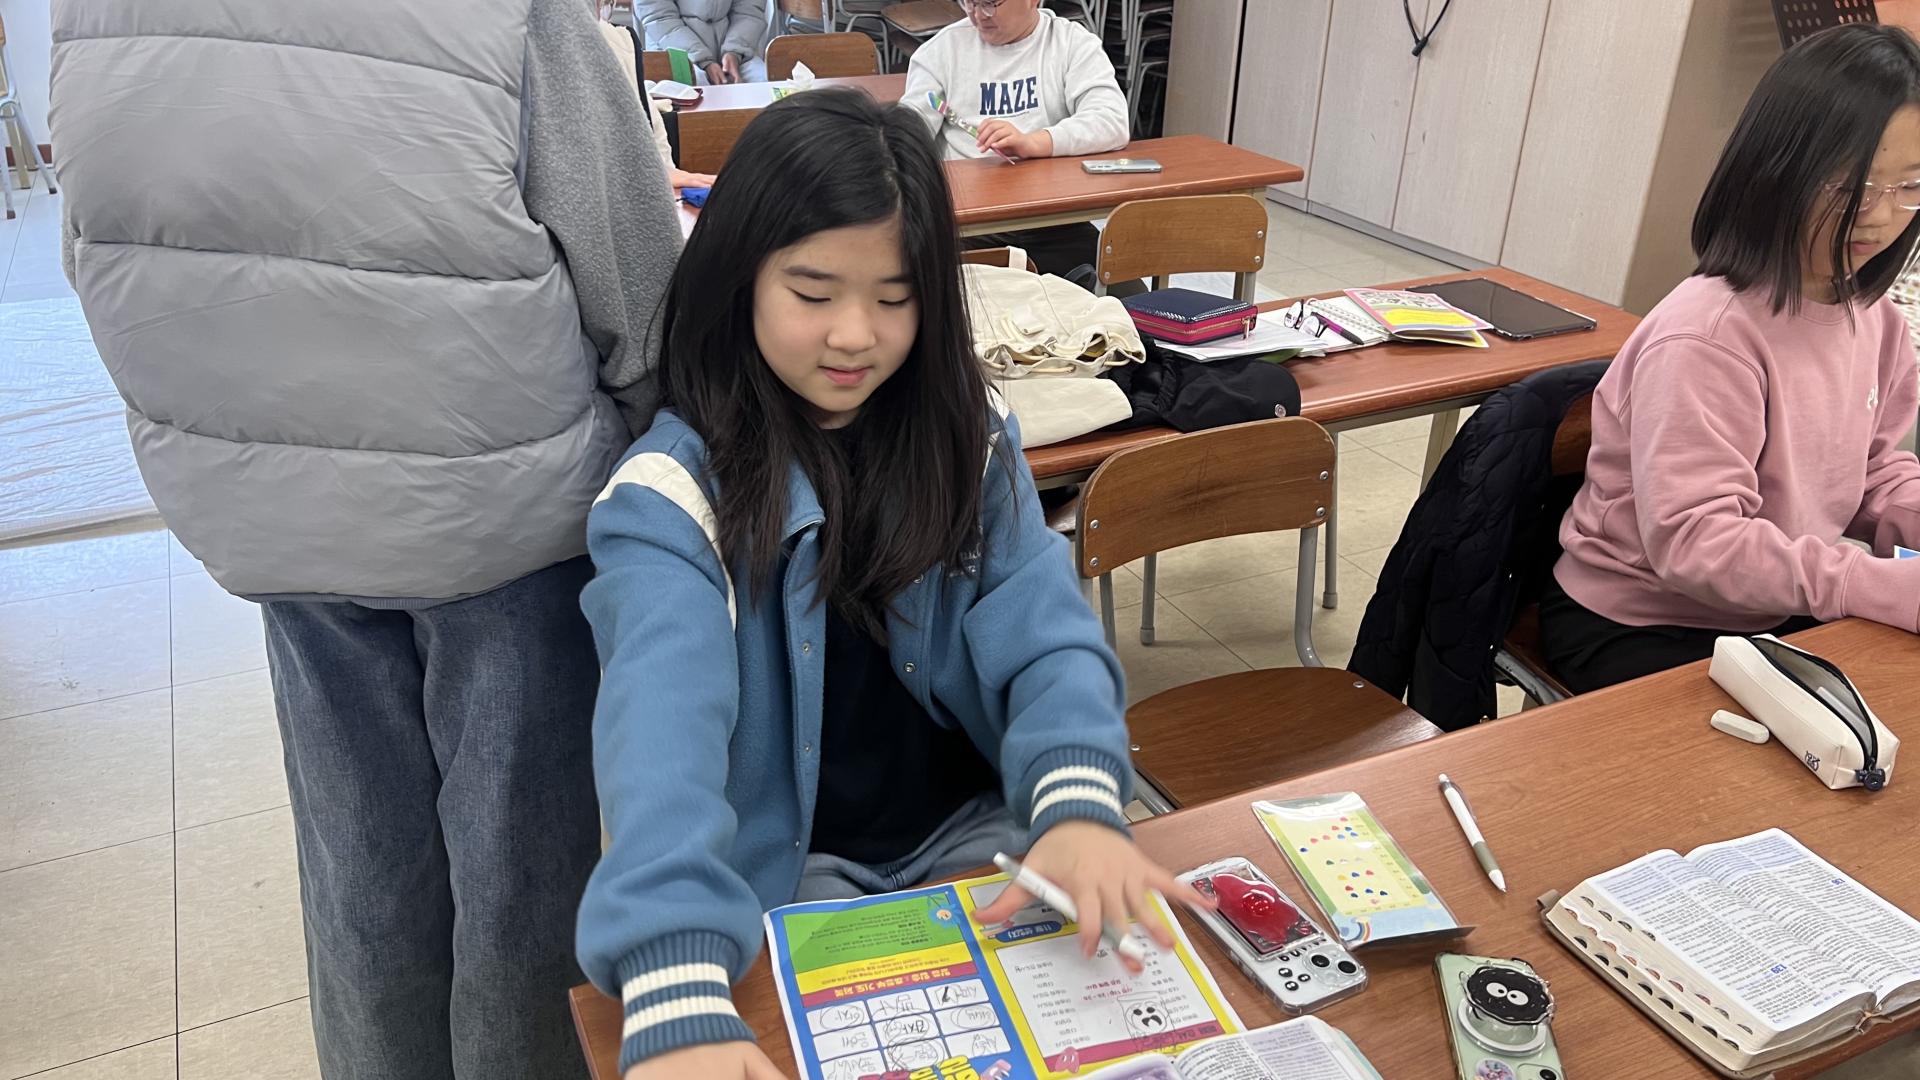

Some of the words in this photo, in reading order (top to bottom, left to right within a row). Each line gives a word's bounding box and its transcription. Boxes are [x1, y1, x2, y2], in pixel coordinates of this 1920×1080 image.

[980, 76, 1038, 115] MAZE
[1770, 963, 1787, 974] 139
[855, 982, 876, 993] 기도
[902, 1019, 926, 1034] 감사
